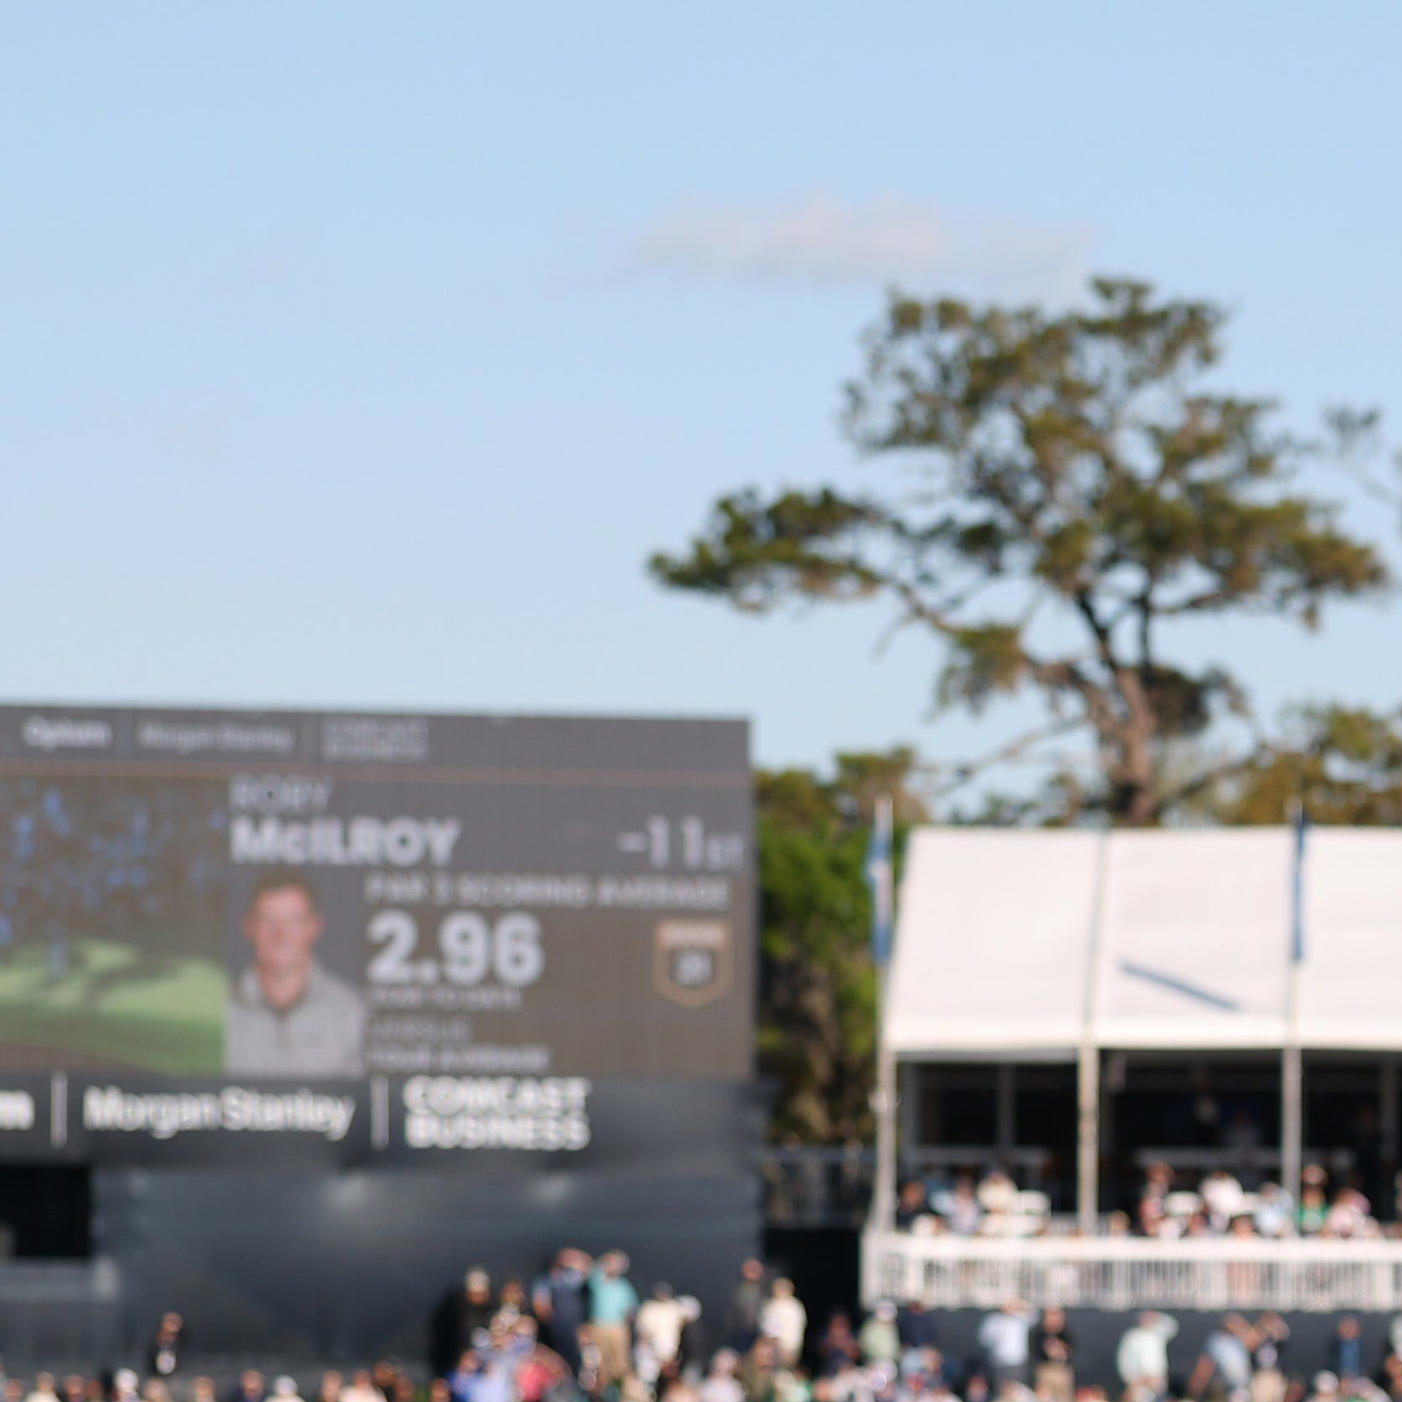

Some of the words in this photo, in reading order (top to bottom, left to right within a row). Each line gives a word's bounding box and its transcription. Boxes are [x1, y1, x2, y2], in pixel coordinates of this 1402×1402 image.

[229, 774, 334, 813] RORY
[230, 814, 462, 866] McILROY
[366, 908, 545, 986] 2.96
[83, 1085, 219, 1141] Morgan
[221, 1085, 357, 1143] Stanley
[402, 1075, 593, 1114] COMCAST
[403, 1112, 592, 1152] BUSINESS
